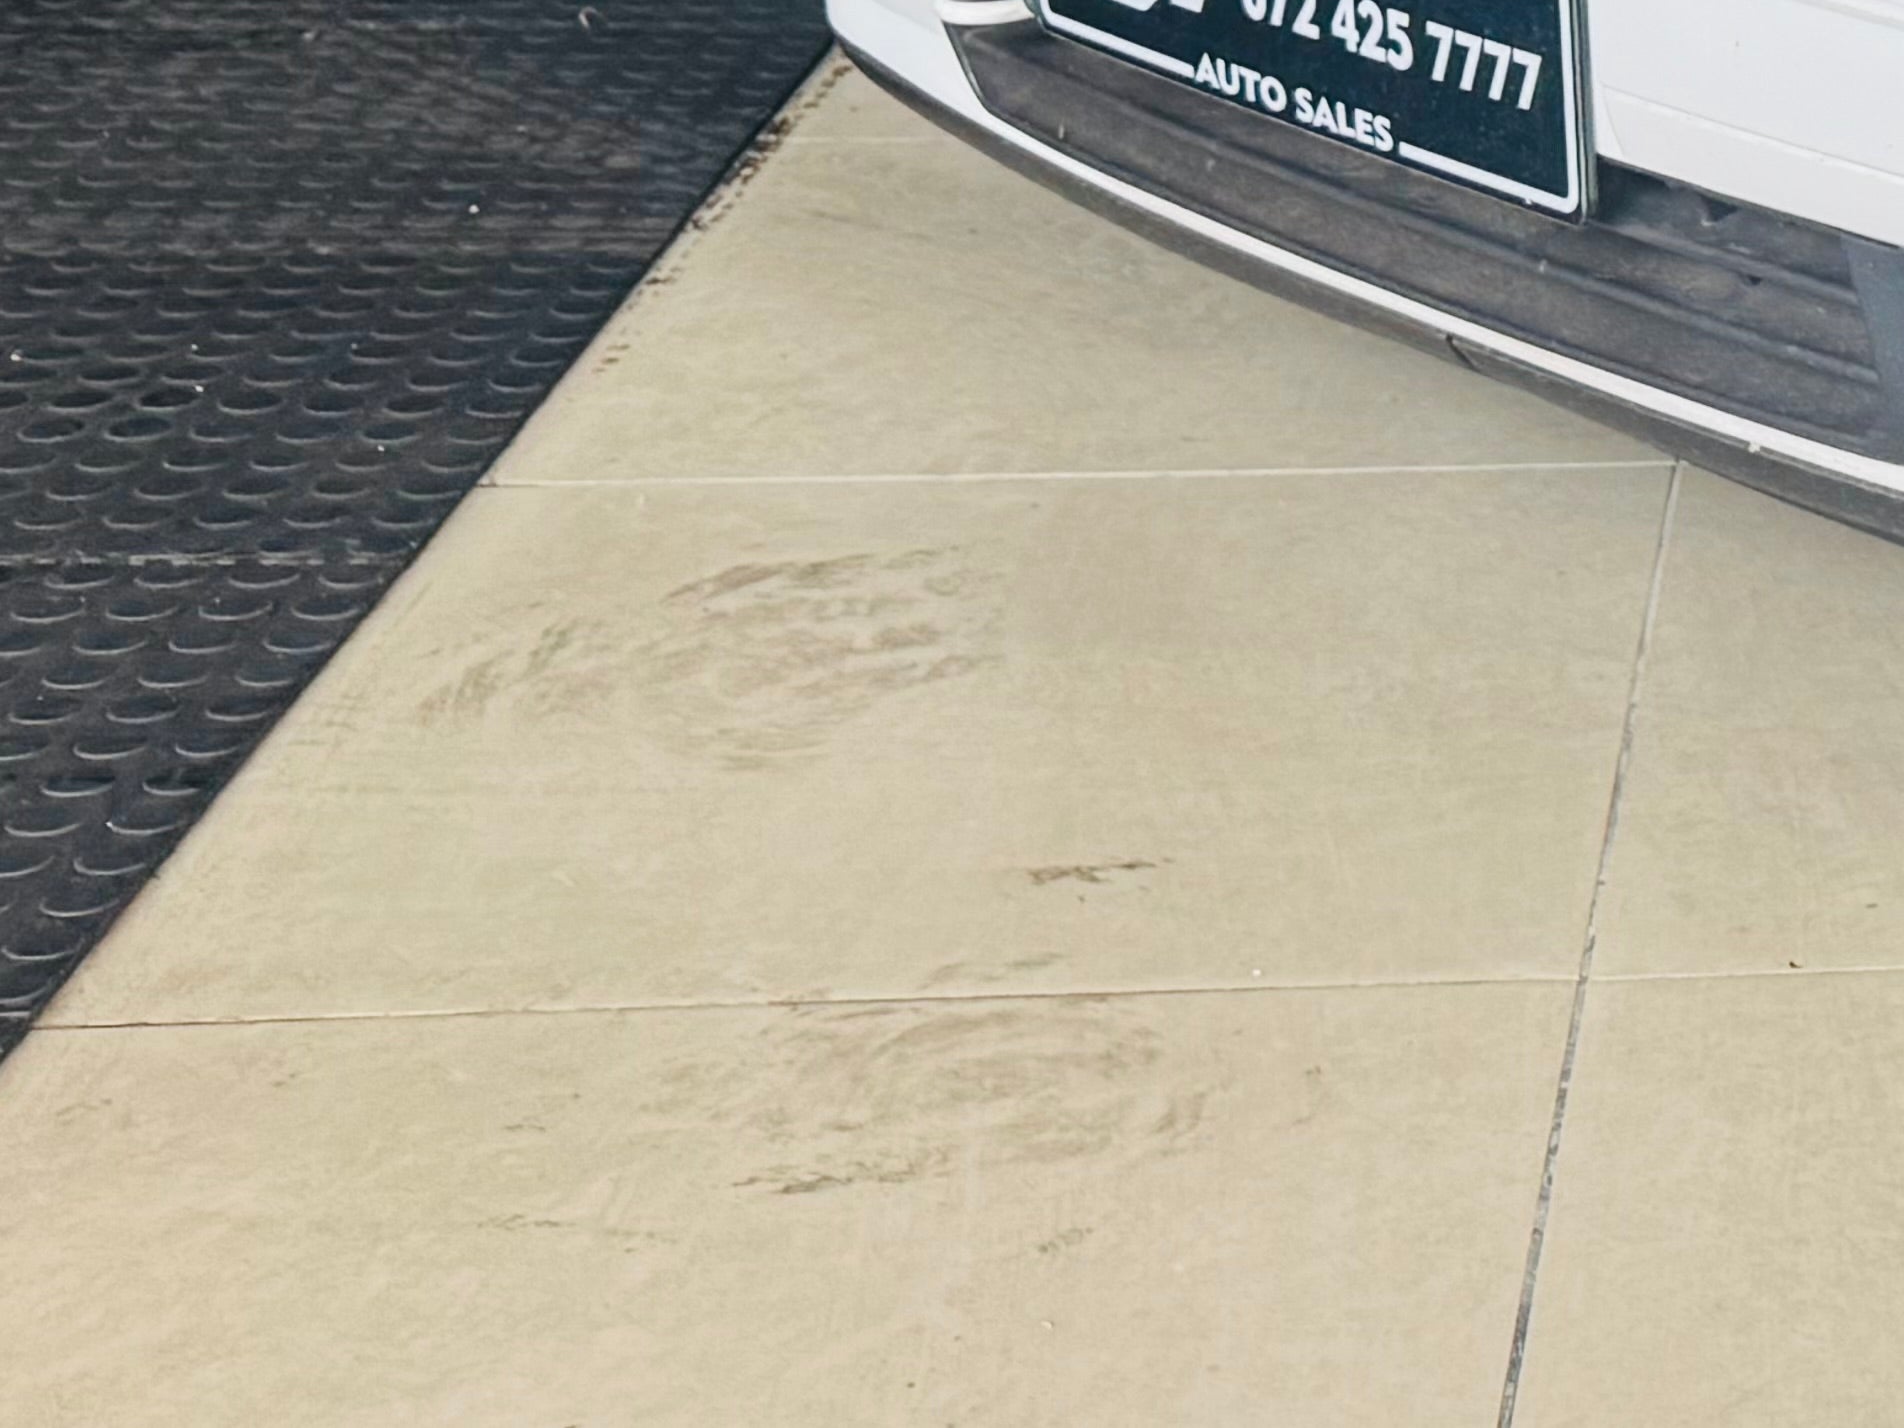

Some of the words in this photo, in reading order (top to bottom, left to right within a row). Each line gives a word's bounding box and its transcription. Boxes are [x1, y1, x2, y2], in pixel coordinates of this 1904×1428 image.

[1194, 51, 1288, 113] AUTO
[1293, 87, 1395, 153] SALES
[1425, 20, 1543, 111] 7777
